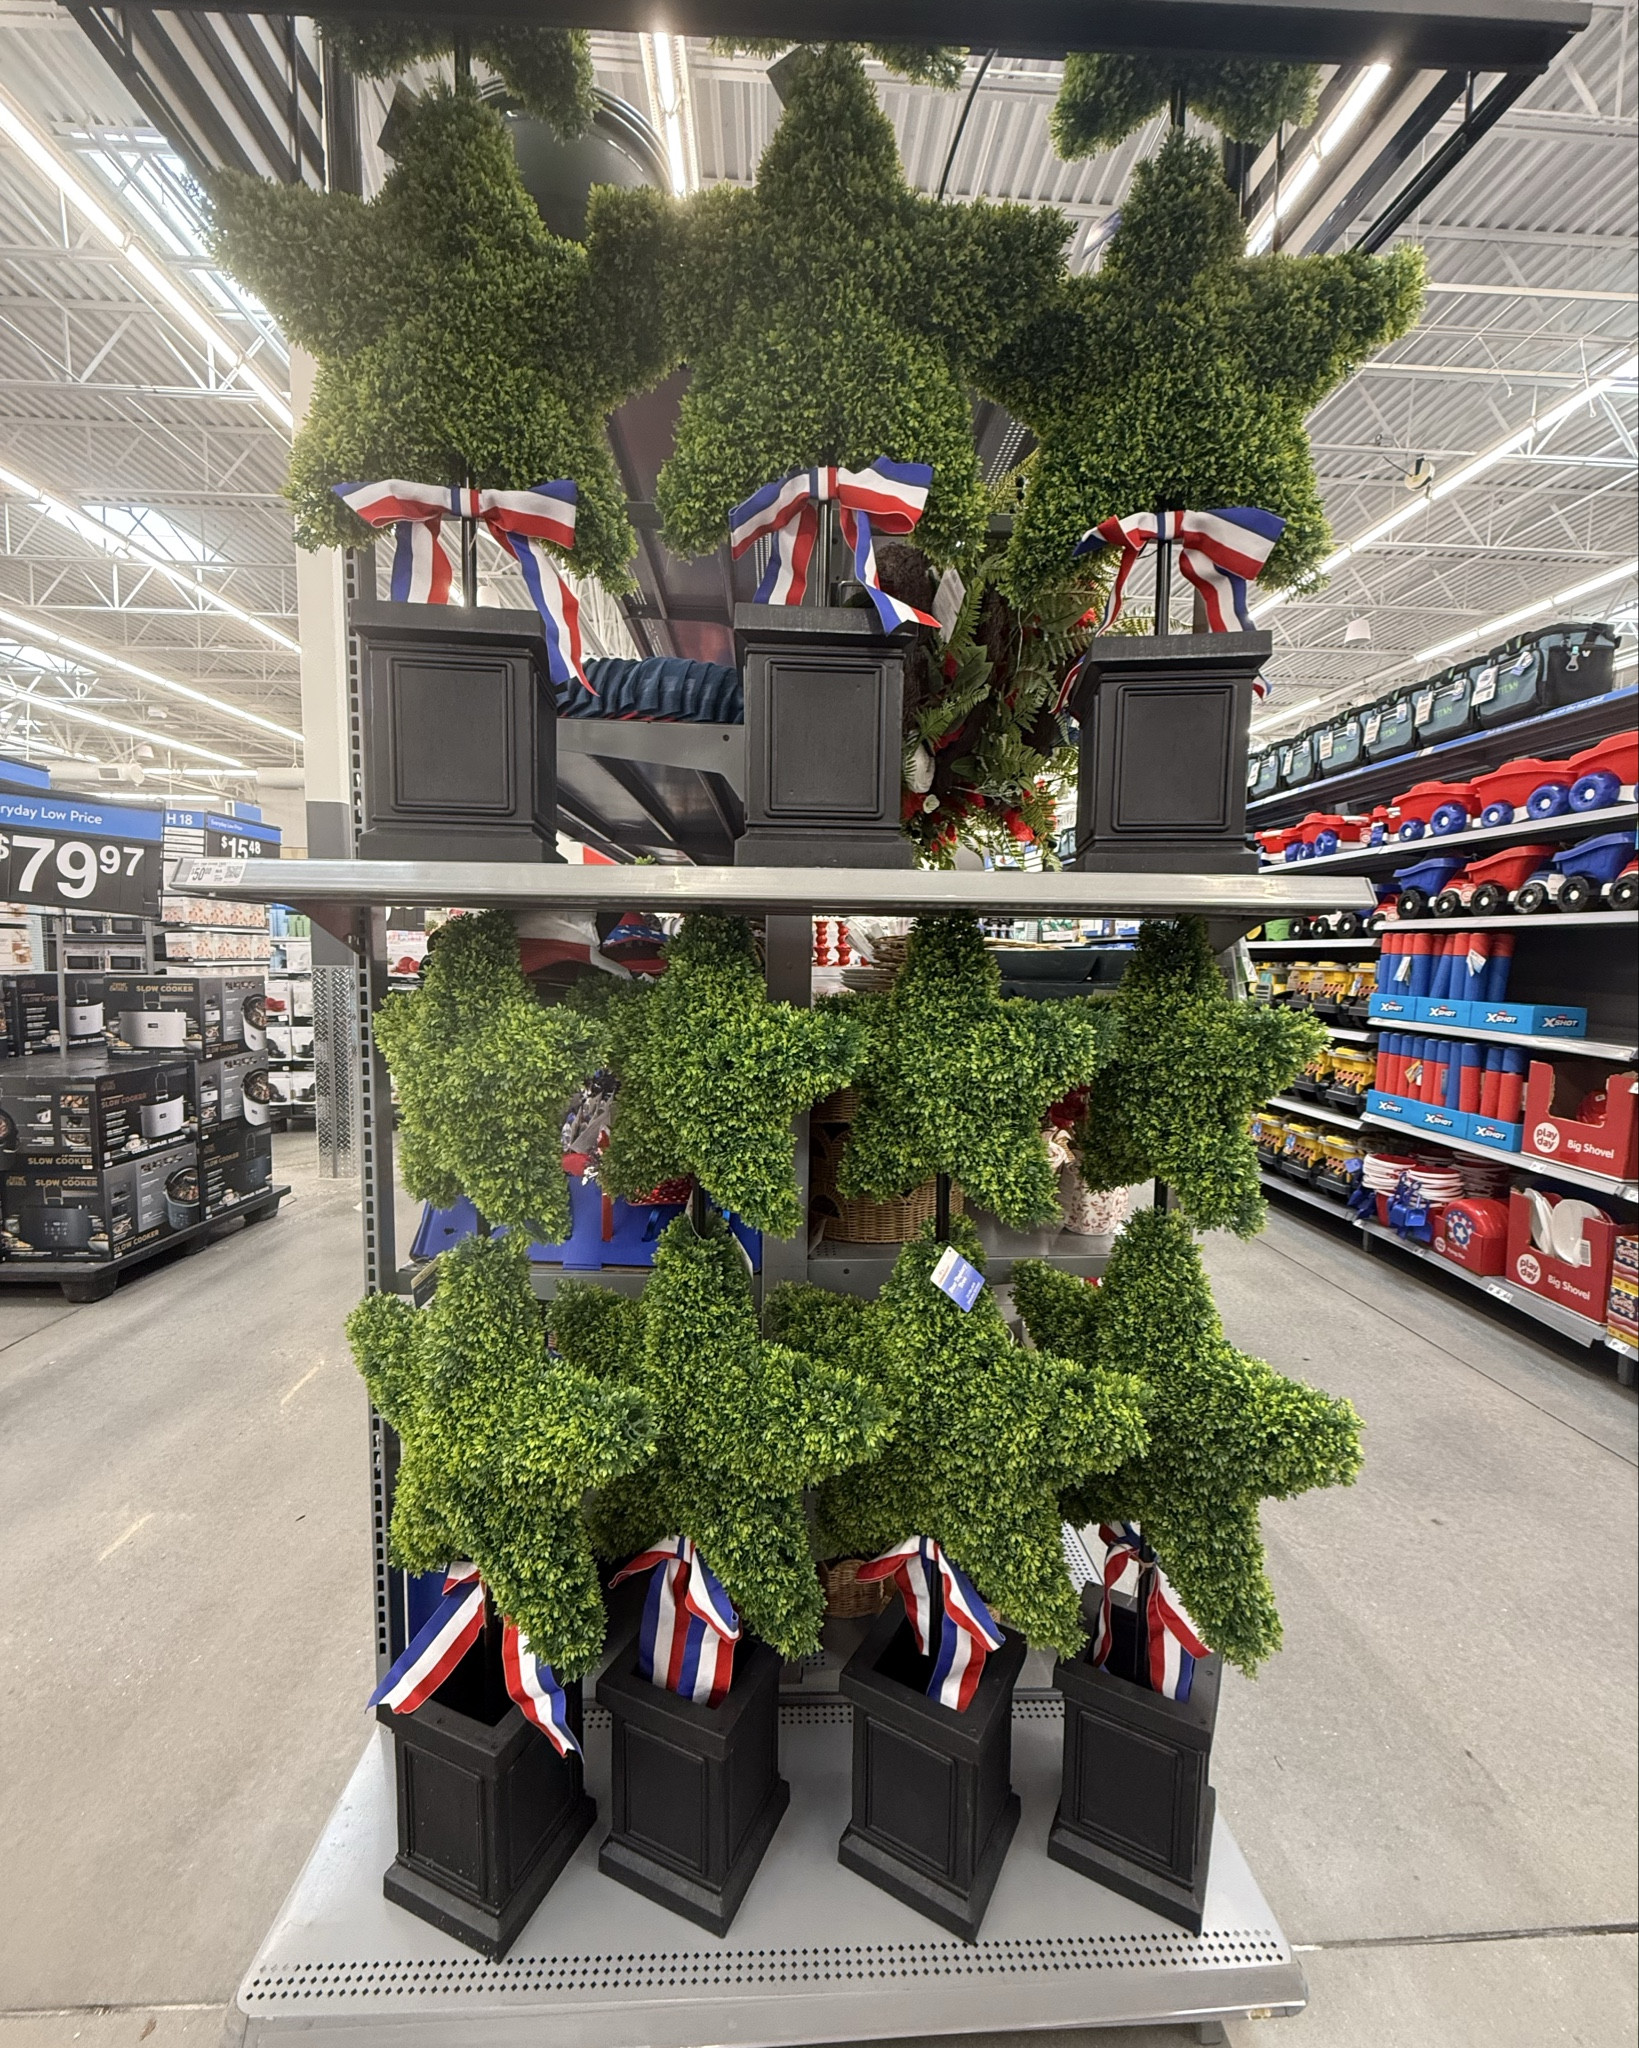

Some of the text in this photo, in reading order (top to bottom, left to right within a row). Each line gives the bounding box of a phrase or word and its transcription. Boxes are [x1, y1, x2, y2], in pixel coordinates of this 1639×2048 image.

[41, 807, 66, 821] Low
[70, 810, 103, 825] Price
[167, 813, 193, 826] H 18
[136, 985, 159, 993] SLOW
[160, 985, 194, 993] COOKER
[1536, 1128, 1557, 1140] play
[1537, 1137, 1555, 1149] day
[1567, 1139, 1615, 1159] Big Shovel
[27, 1157, 93, 1165] SLOW COOKER
[35, 1179, 60, 1187] SLOW
[62, 1178, 98, 1187] COOKER
[133, 1229, 160, 1244] COOKER
[1520, 1259, 1538, 1273] play
[1520, 1268, 1536, 1281] day
[1547, 1274, 1591, 1300] Big Shovel
